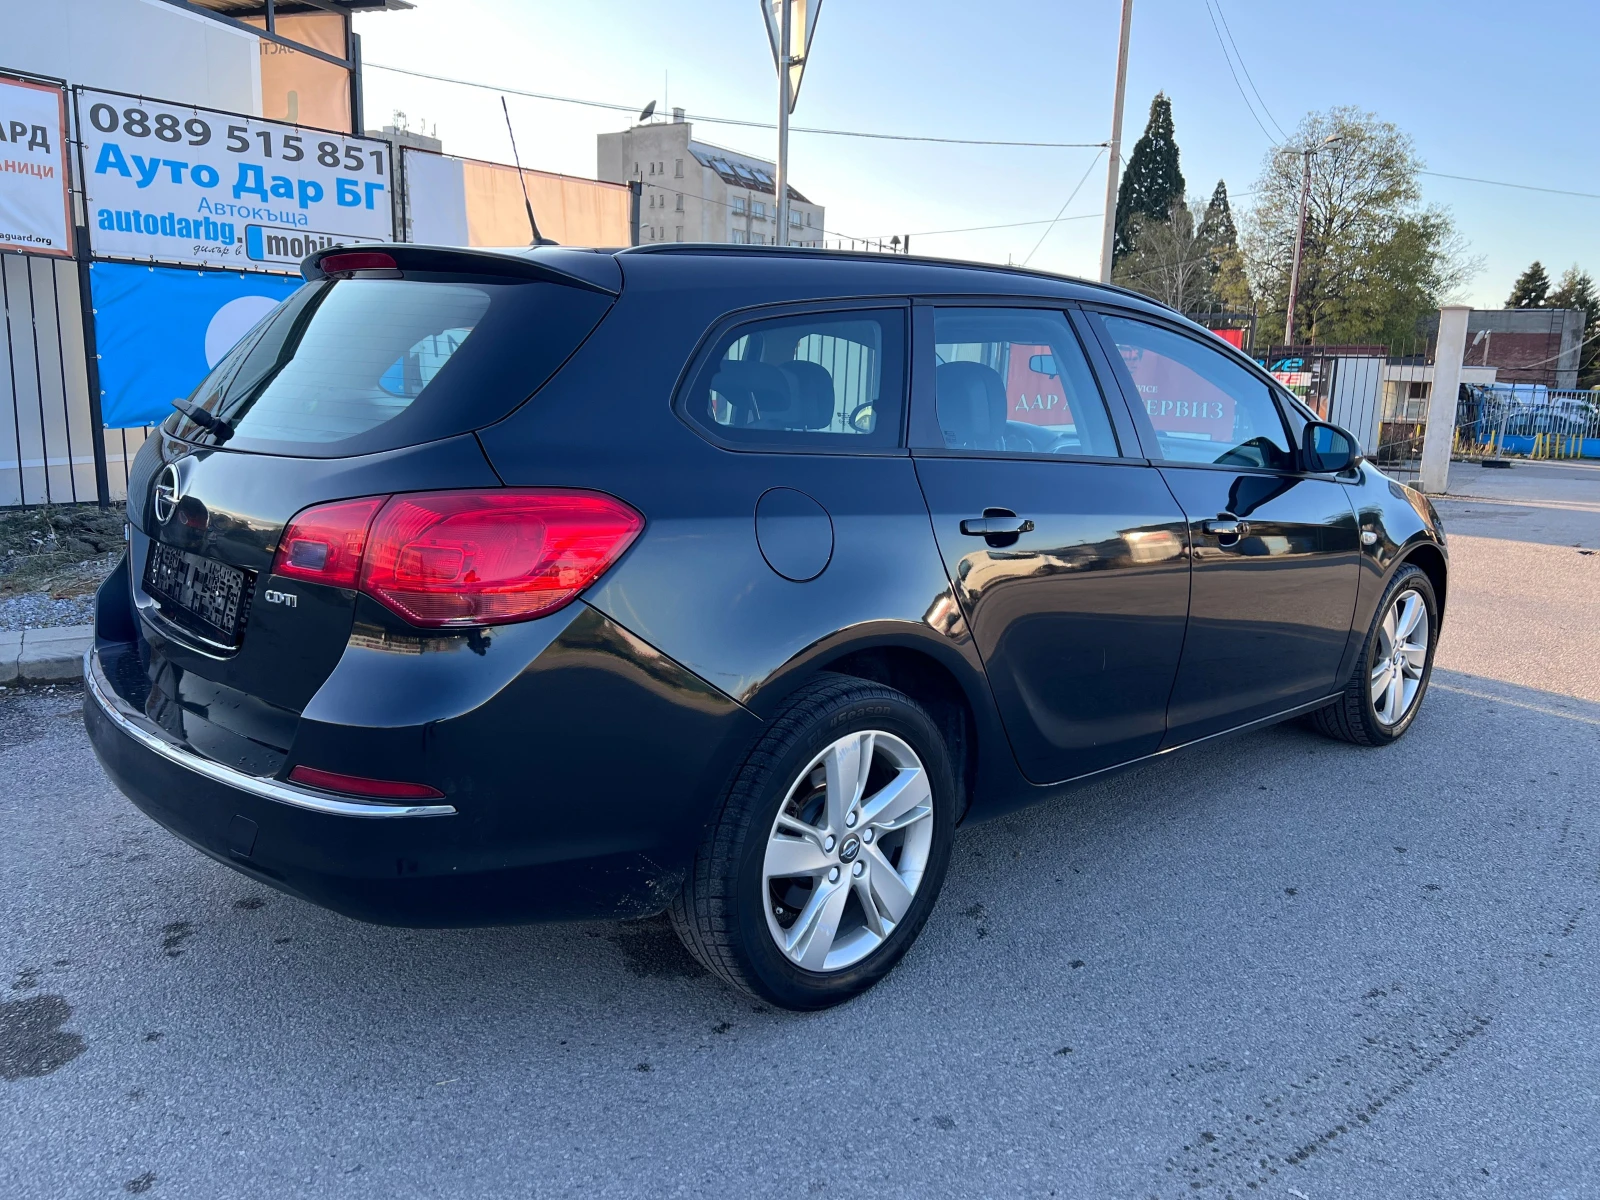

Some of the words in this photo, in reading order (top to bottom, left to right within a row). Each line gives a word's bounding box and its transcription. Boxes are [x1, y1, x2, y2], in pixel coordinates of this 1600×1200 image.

[89, 103, 212, 146] 0889
[226, 124, 304, 162] 515
[317, 141, 384, 176] 851
[0, 159, 54, 179] НИЦИ
[94, 142, 220, 189] Ауто
[232, 162, 324, 209] Дар
[335, 177, 385, 211] БГ
[197, 196, 308, 227] Автокъща
[1015, 393, 1059, 413] ДАР
[1145, 398, 1224, 420] ЕРВИЗ
